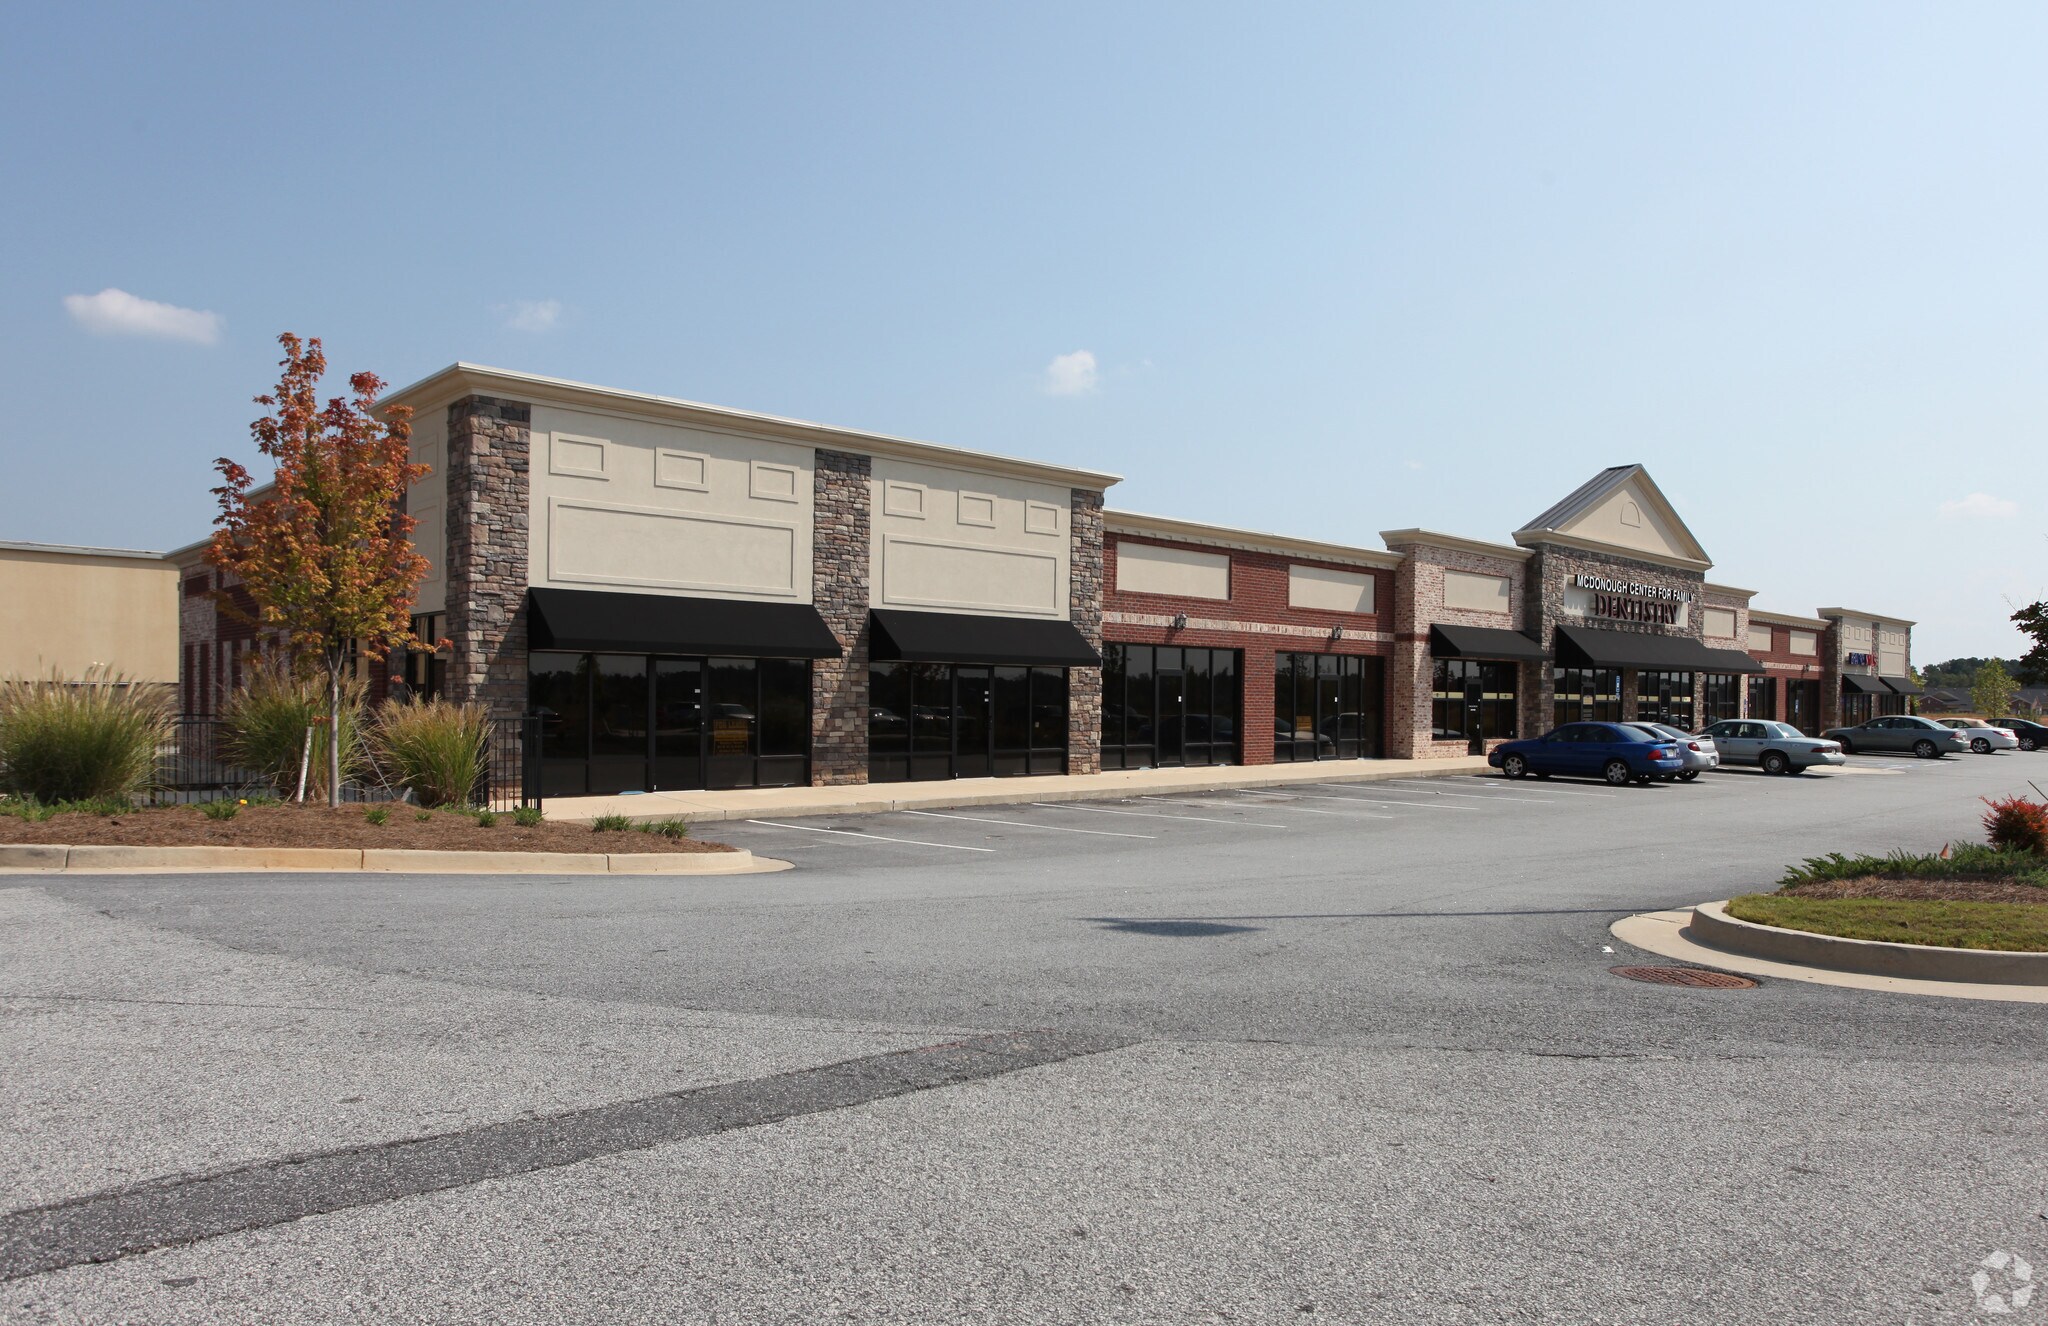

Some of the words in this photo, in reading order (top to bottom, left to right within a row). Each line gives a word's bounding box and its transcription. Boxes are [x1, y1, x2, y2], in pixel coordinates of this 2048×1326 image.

[1577, 574, 1628, 593] MCDONOUGH
[1630, 583, 1657, 598] CENTER
[1658, 587, 1672, 600] FOR
[1673, 590, 1695, 603] FAMILY
[1594, 593, 1677, 624] DENTISTRY
